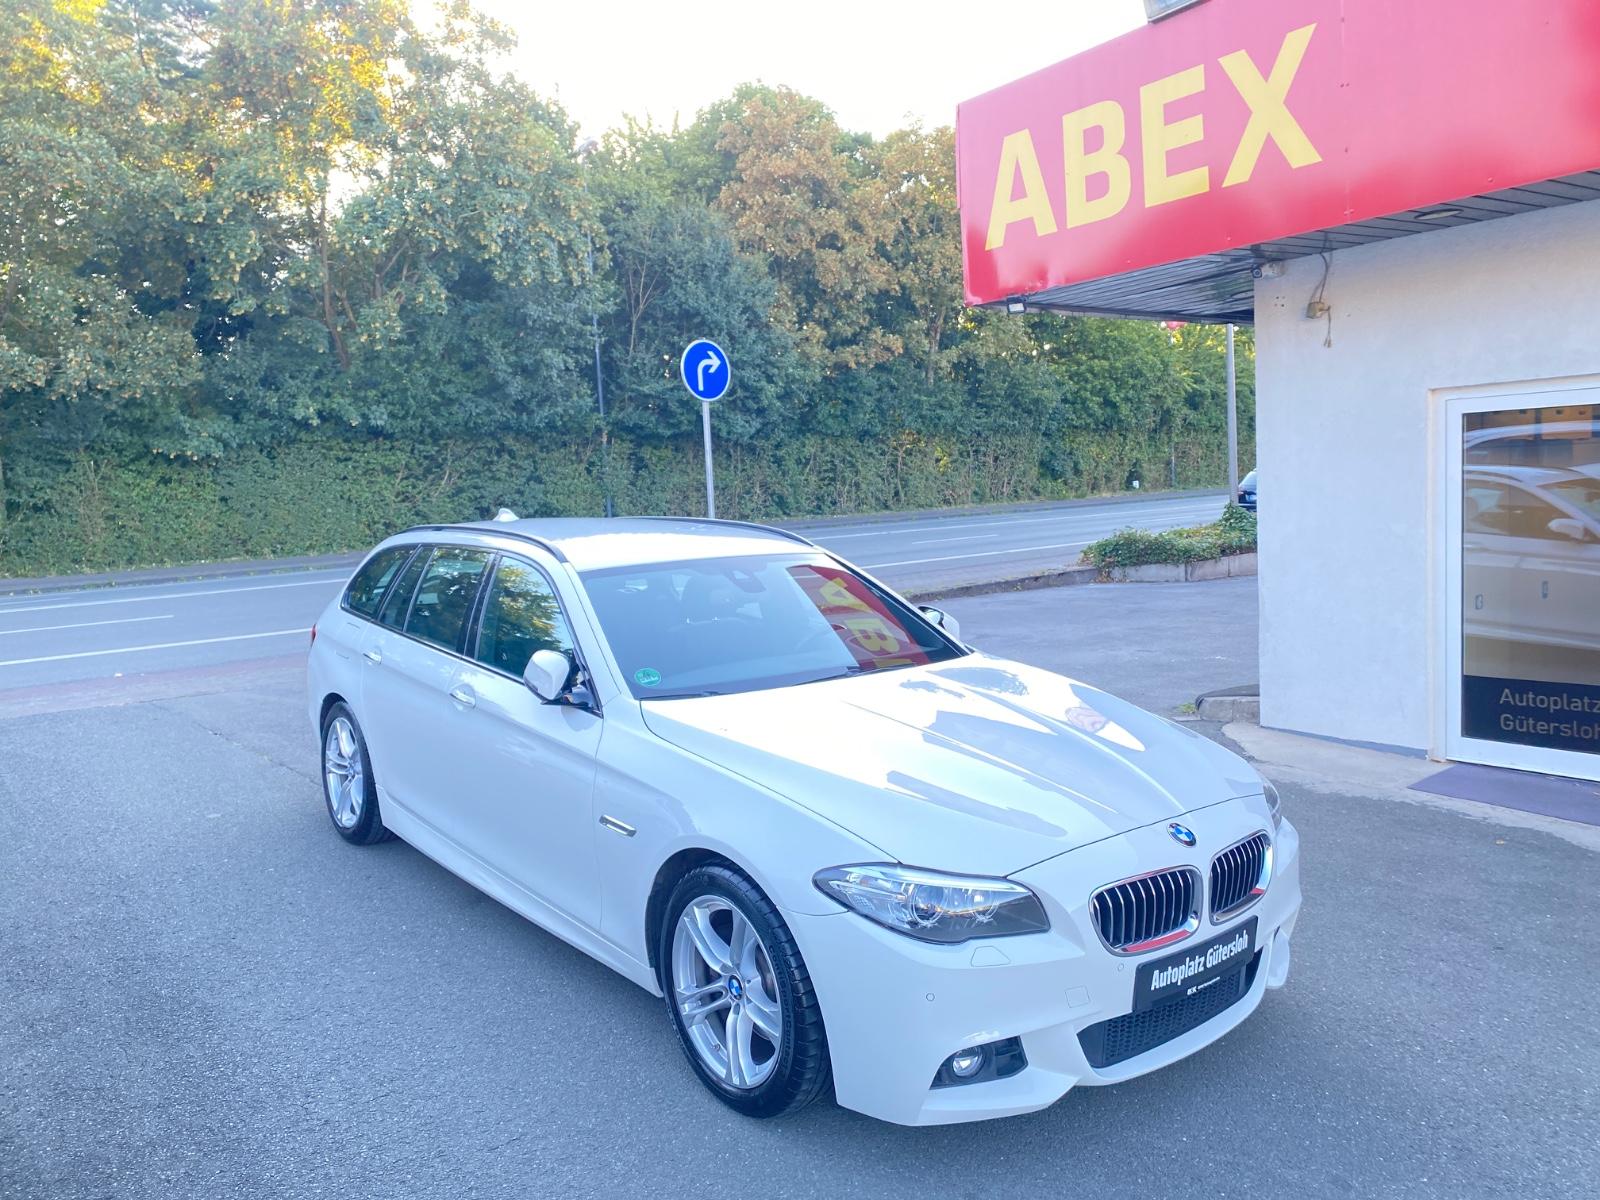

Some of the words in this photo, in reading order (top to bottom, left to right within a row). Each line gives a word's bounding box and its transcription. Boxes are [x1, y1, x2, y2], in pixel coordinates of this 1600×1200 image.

[985, 22, 1323, 251] ABEX
[1500, 688, 1600, 713] Autoplatz
[1151, 956, 1204, 990] Autoplatz
[1206, 930, 1248, 968] Gütersloh
